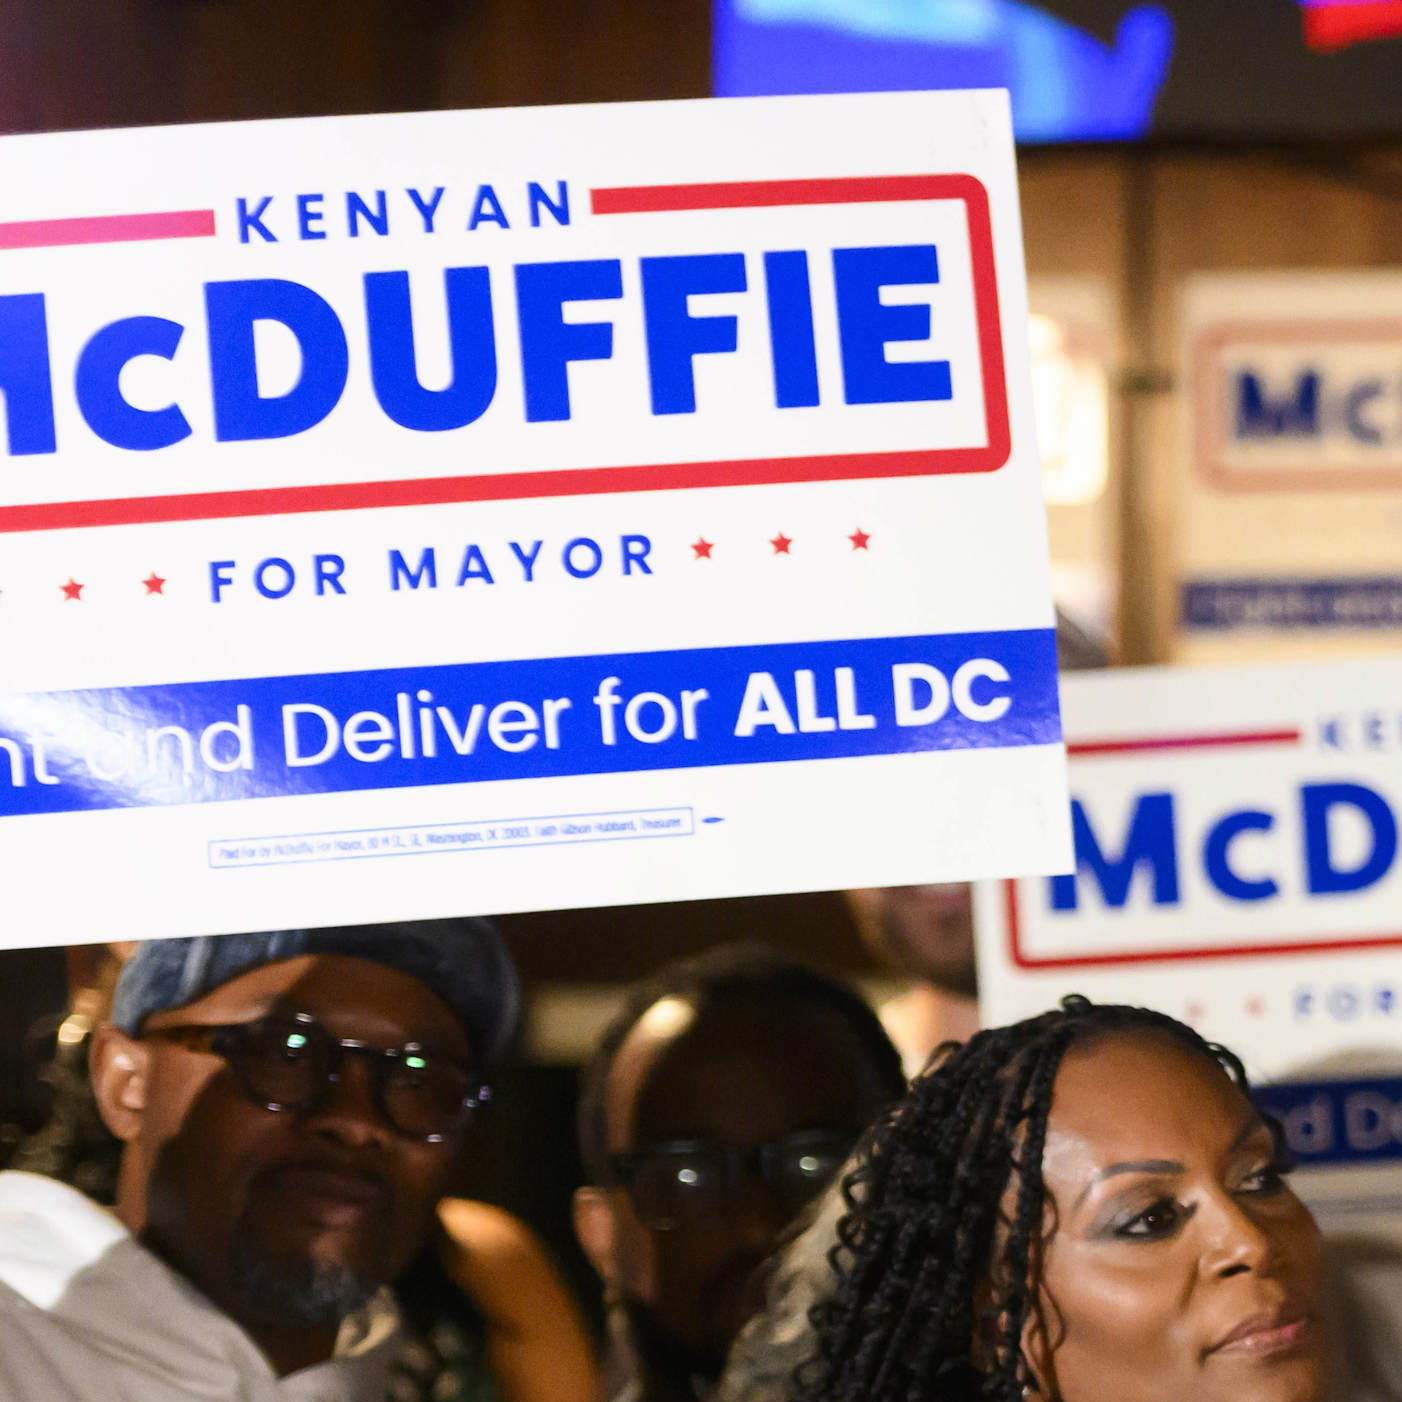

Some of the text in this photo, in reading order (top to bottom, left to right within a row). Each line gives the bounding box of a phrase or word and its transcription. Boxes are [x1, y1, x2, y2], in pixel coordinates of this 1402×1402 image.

[237, 180, 571, 244] KENYAN
[210, 534, 653, 603] FOR MAYOR
[87, 704, 253, 781] and
[281, 689, 572, 768] Deliver
[592, 676, 709, 746] for
[734, 666, 877, 737] ALL
[892, 658, 1012, 730] DC
[1294, 984, 1397, 1018] FOR
